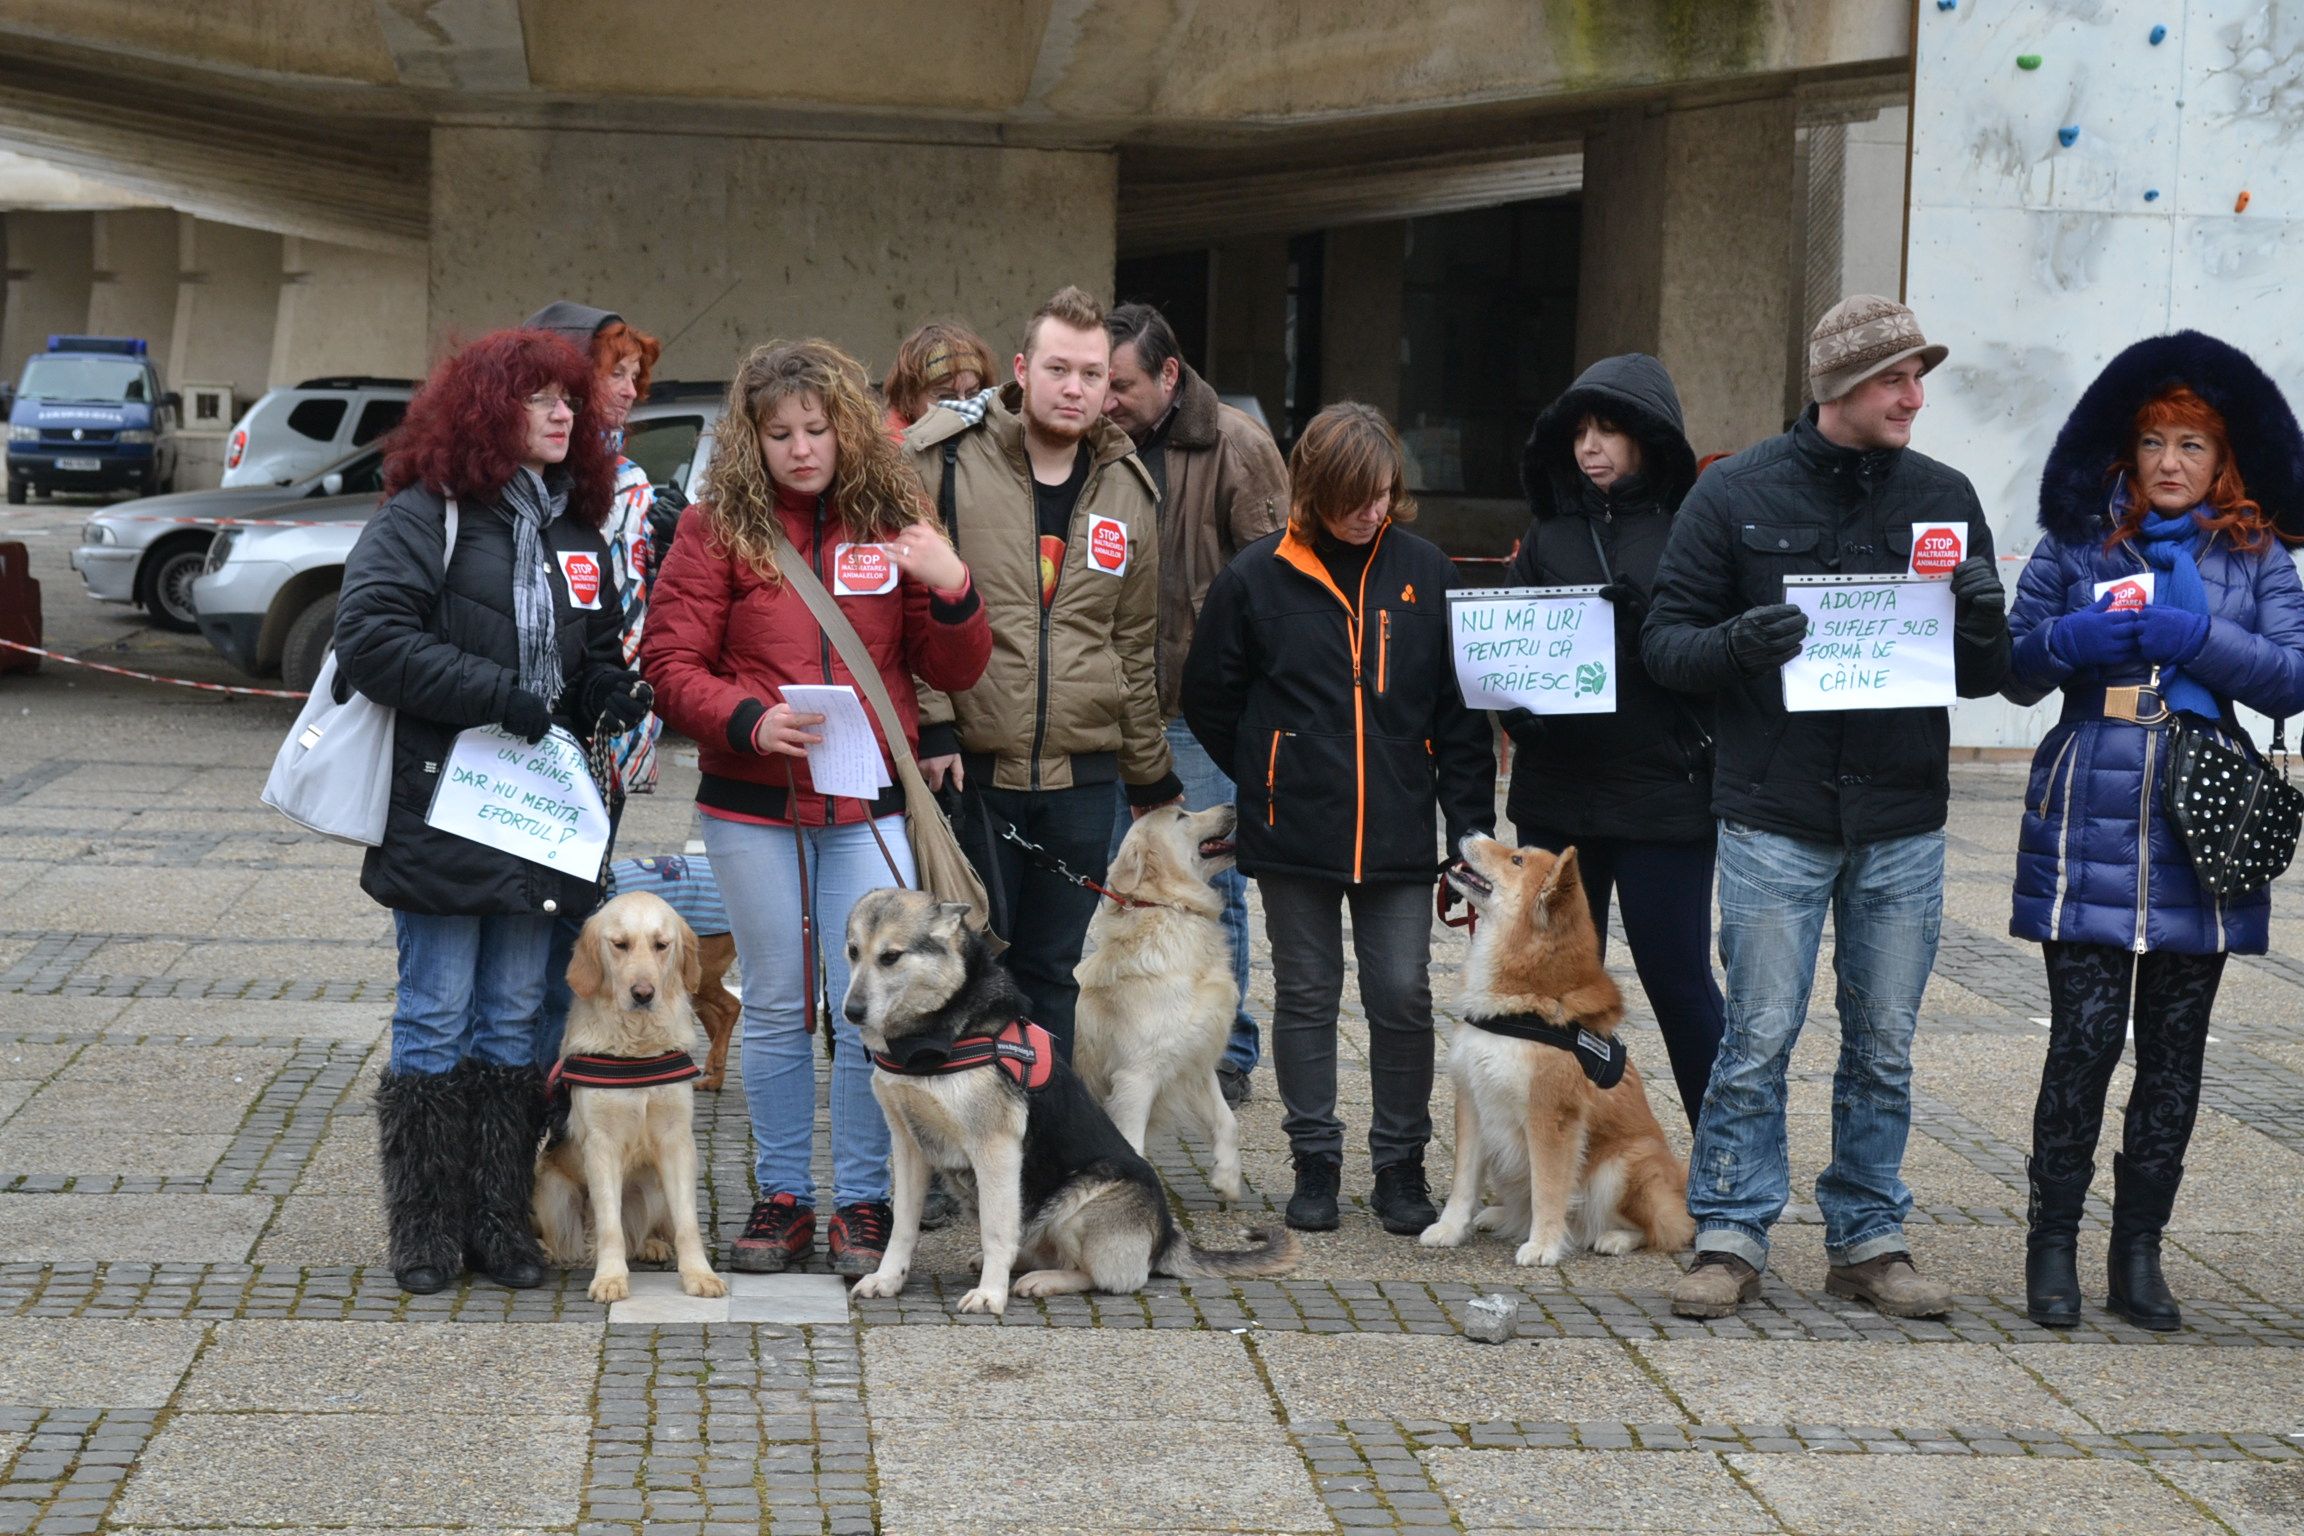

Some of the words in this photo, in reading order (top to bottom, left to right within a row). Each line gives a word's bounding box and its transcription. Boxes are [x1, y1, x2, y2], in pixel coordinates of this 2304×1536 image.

[1099, 527, 1120, 542] STOP
[1924, 537, 1954, 550] STOP
[848, 553, 880, 565] STOP
[570, 563, 593, 575] STOP
[2113, 587, 2137, 602] TOP
[1461, 608, 1495, 633] NU
[1823, 618, 1897, 637] SUFLET
[1897, 618, 1939, 637] SUB
[1463, 637, 1541, 664] PENTRU
[1871, 640, 1897, 659] DE
[497, 748, 525, 765] UN
[452, 766, 488, 790] DAR
[493, 781, 519, 799] NU
